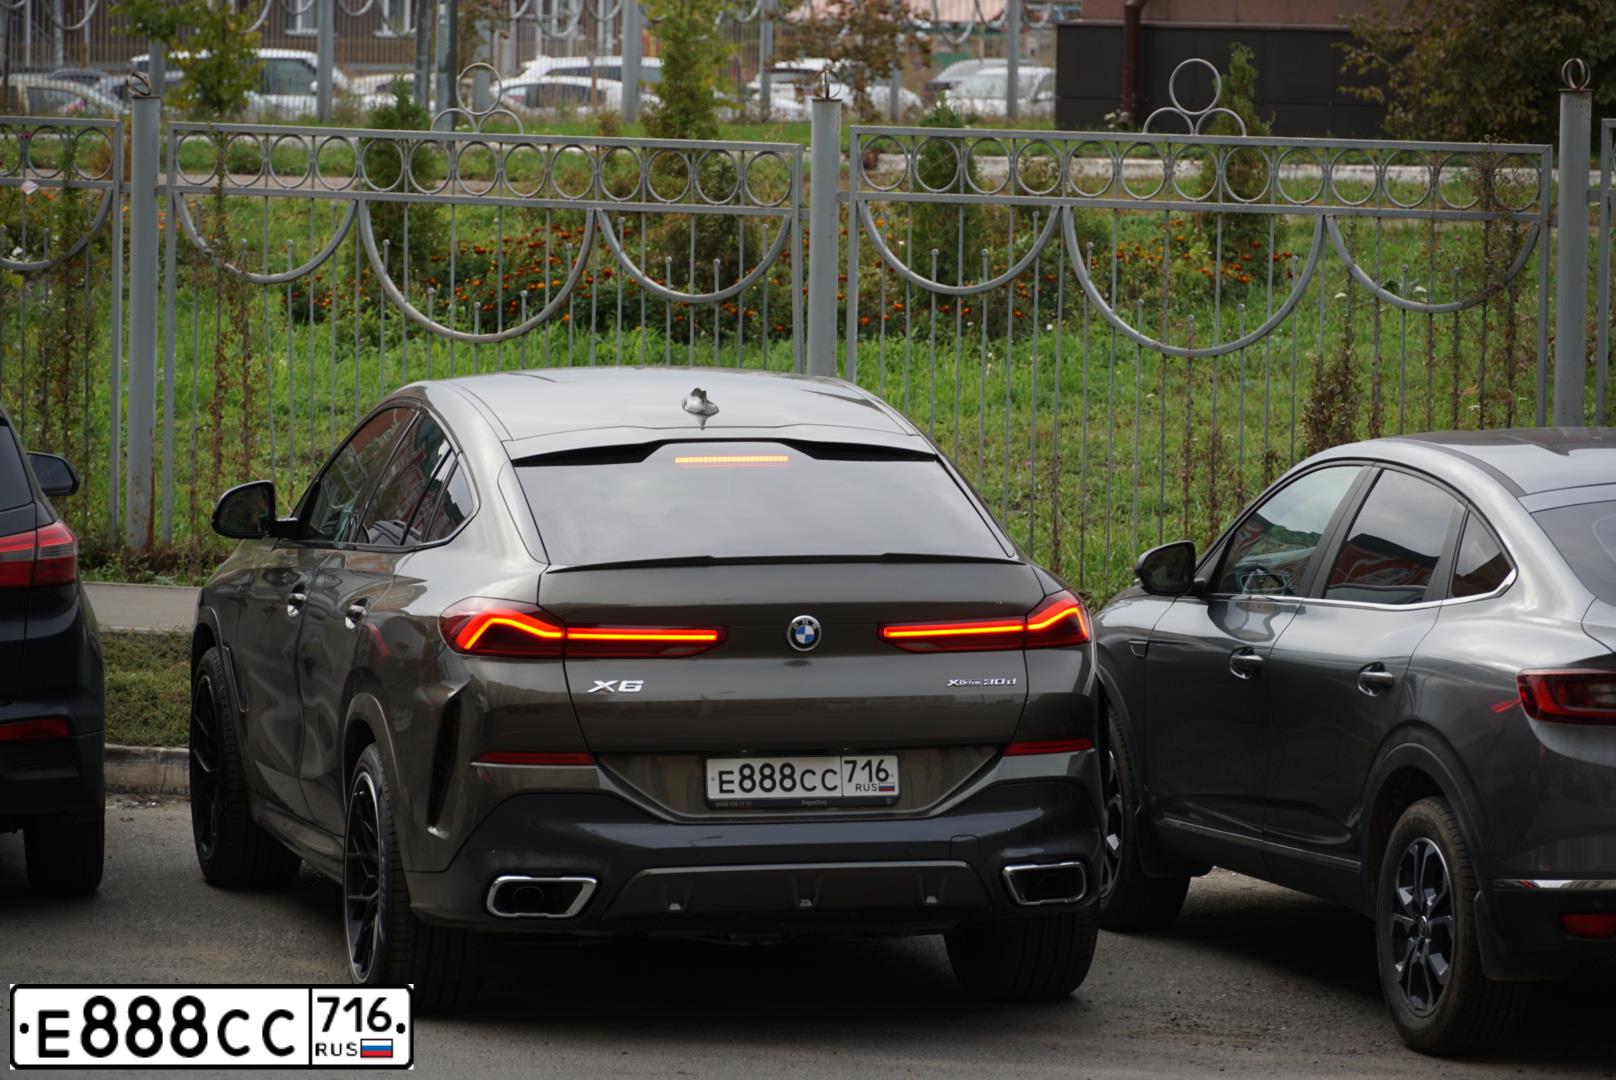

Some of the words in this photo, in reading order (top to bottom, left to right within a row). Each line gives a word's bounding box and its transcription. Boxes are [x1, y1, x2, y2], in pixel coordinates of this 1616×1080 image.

[586, 679, 645, 693] X6
[843, 759, 890, 783] 716
[855, 783, 878, 792] RUS
